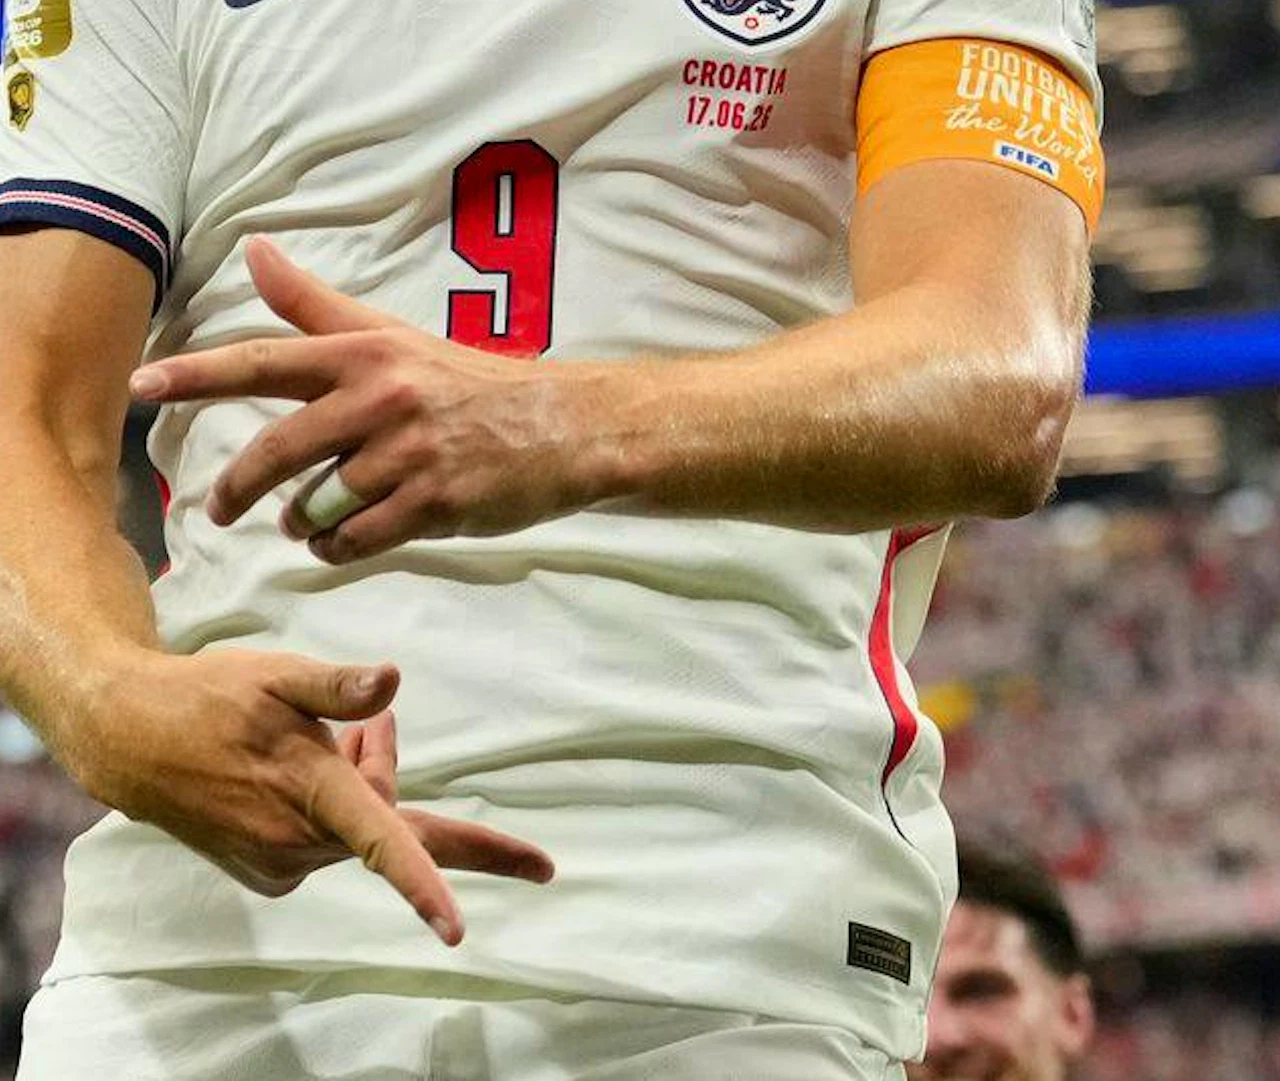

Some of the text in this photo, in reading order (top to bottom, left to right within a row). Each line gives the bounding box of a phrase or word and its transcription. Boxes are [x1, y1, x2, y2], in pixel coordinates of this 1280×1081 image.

[682, 59, 787, 95] CROATIA
[944, 101, 1007, 131] the
[999, 144, 1055, 176] FIFA
[446, 139, 560, 361] 9
